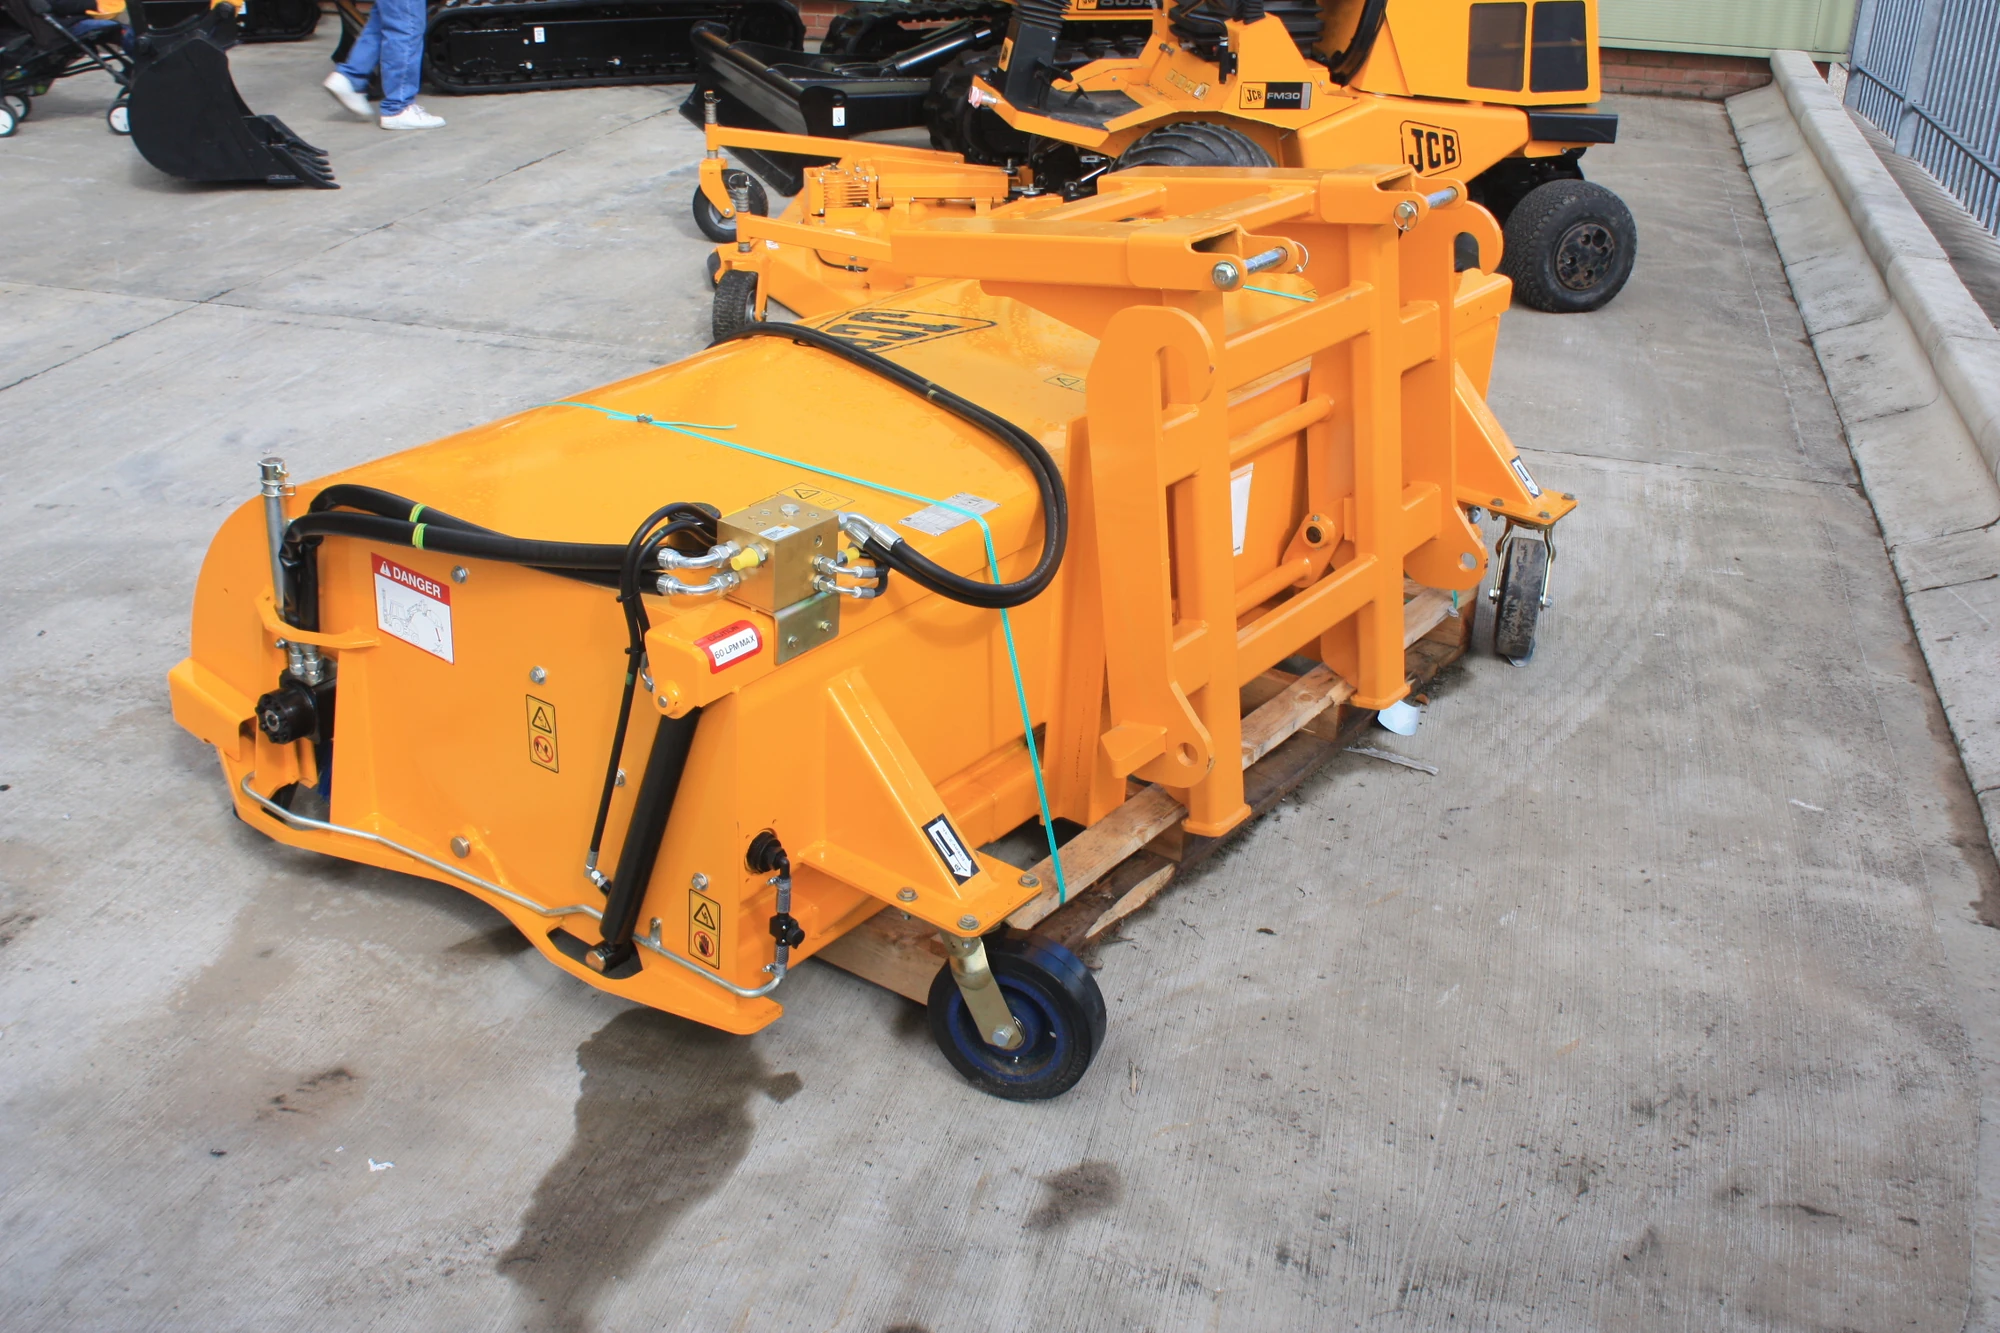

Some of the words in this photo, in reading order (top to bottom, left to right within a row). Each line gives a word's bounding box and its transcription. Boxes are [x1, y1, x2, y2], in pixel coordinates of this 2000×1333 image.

[1246, 89, 1262, 103] JCB
[1266, 91, 1301, 100] FM30
[1408, 127, 1457, 174] JCB
[393, 566, 441, 598] DANGER
[714, 649, 725, 659] 60
[725, 642, 740, 654] LPM
[739, 635, 755, 647] MAX
